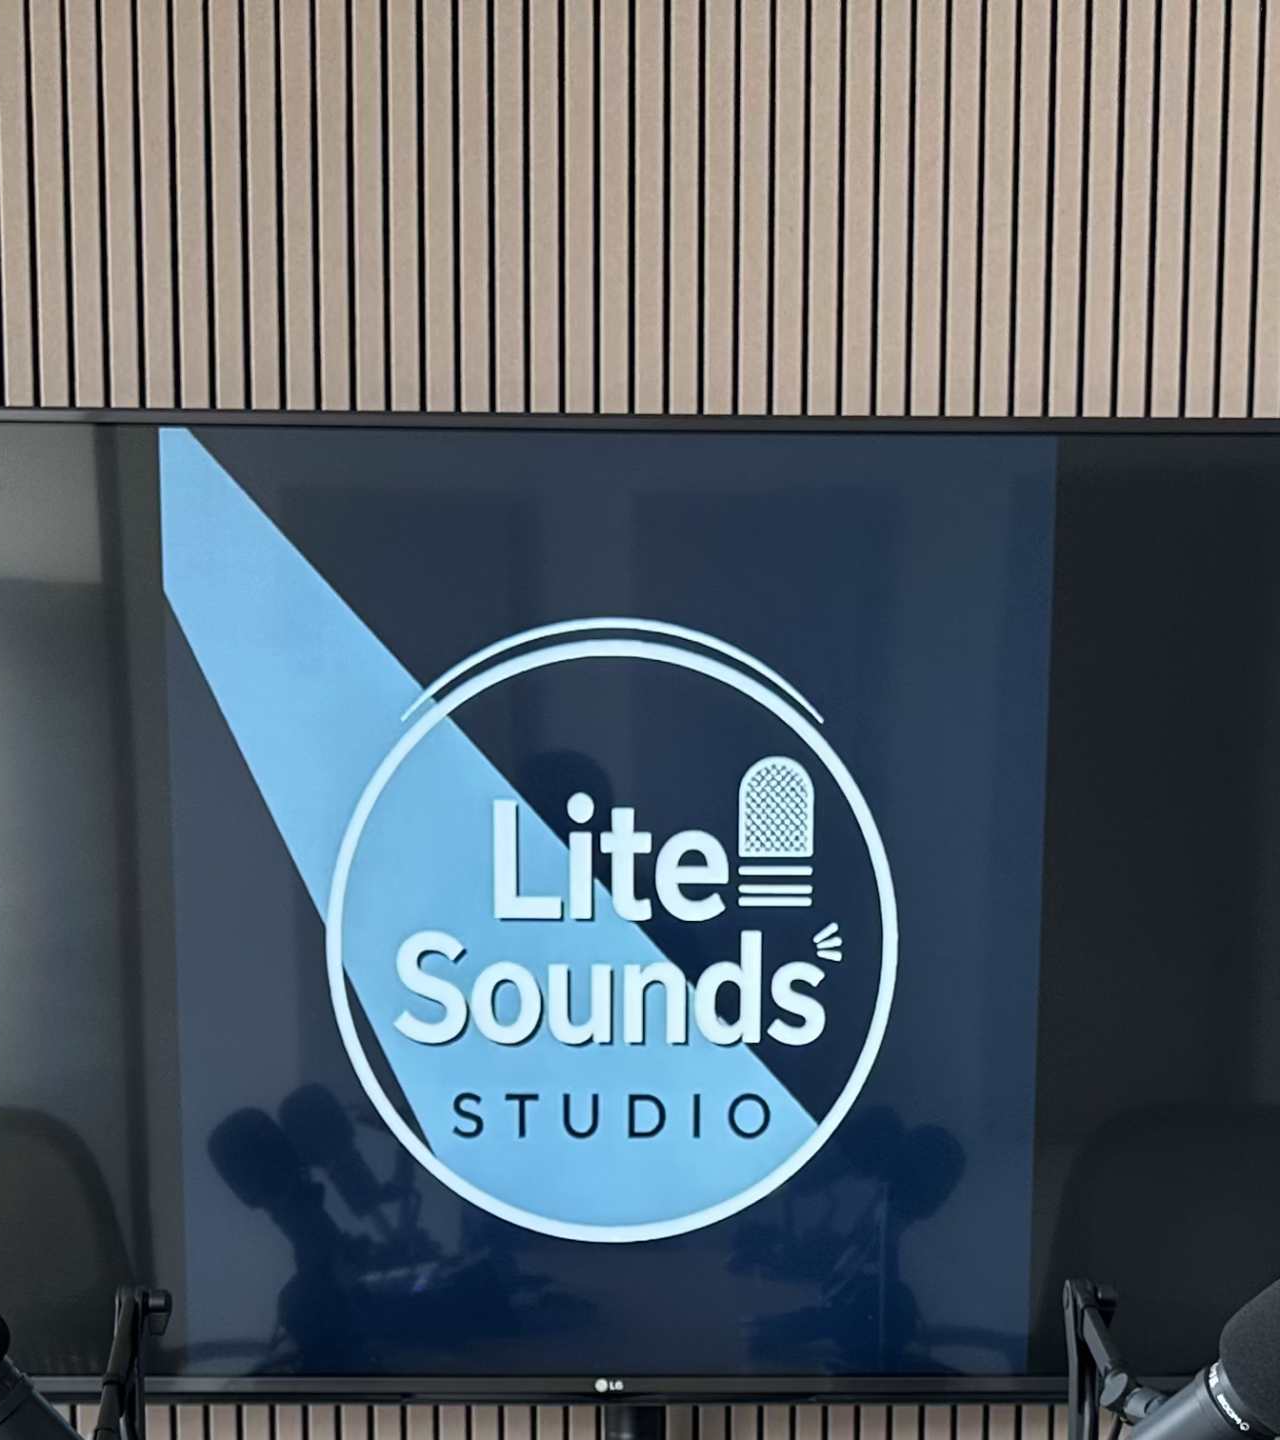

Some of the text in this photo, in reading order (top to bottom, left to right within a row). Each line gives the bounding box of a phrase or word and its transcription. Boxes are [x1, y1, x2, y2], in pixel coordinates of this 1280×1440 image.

[492, 792, 730, 922] Lite
[393, 929, 827, 1047] Sounds
[452, 1092, 772, 1140] STUDIO
[609, 1380, 624, 1391] LG
